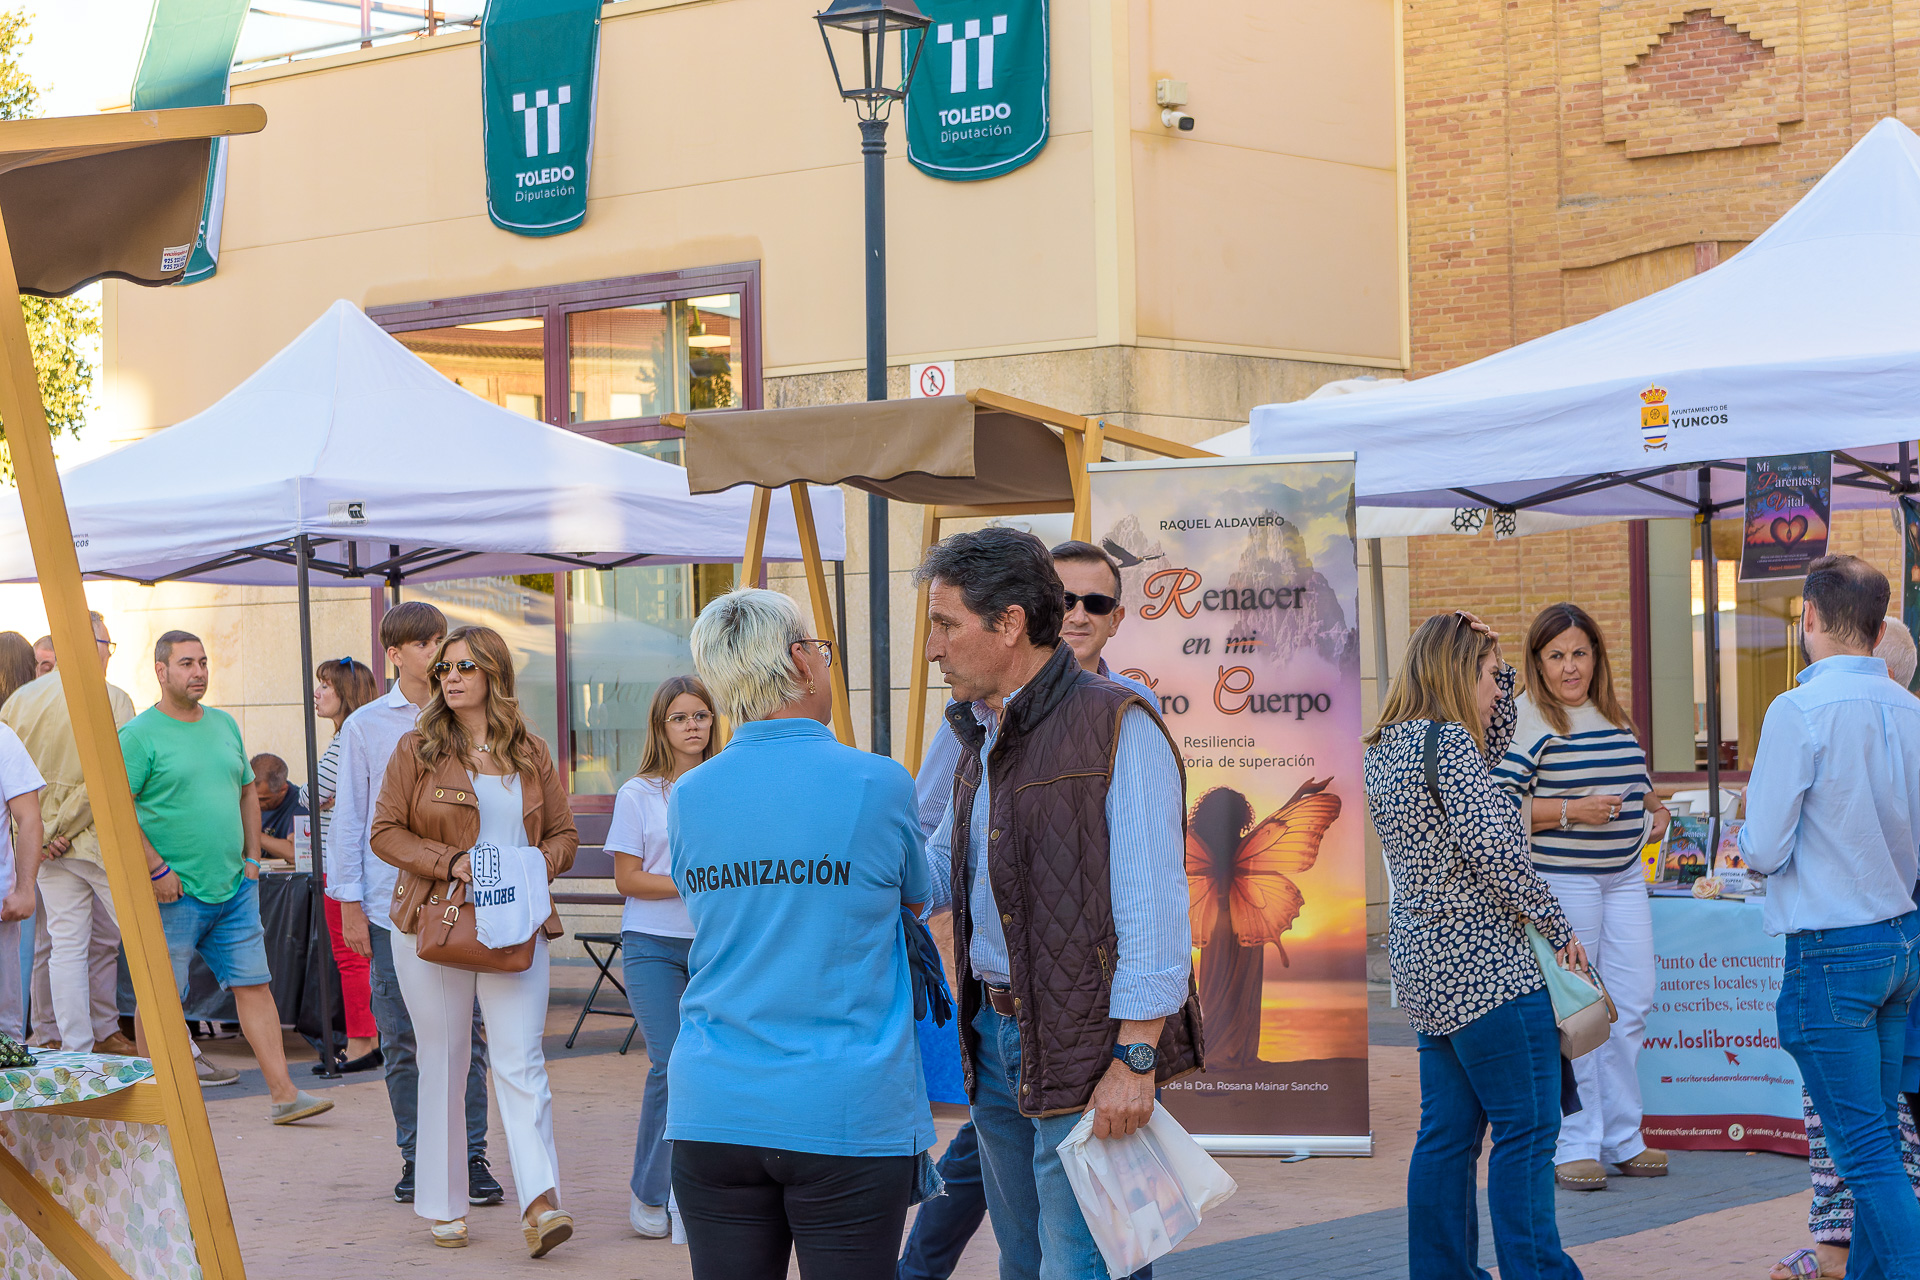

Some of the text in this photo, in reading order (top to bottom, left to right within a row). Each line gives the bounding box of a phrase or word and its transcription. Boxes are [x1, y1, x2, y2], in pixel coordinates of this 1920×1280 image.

[939, 102, 1011, 127] TOLEDO
[941, 124, 1012, 143] Diputación
[515, 165, 575, 188] TOLEDO
[515, 185, 575, 203] Diputación
[1671, 405, 1718, 416] AYUNTAMIENTO
[1671, 414, 1728, 429] YUNCOS
[1756, 461, 1770, 473] Mi
[1757, 471, 1821, 490] Paréntesis
[1766, 491, 1804, 512] Vital
[1159, 516, 1285, 532] RAQUEL ALDAVERO
[1140, 567, 1307, 620] Renacer
[1182, 630, 1257, 655] en mi
[1213, 665, 1332, 721] Cuerpo
[1183, 735, 1255, 748] Resiliencia
[1182, 754, 1315, 770] toria de superación
[686, 853, 851, 894] ORGANIZACIÓN
[474, 886, 516, 908] BROWN
[1653, 954, 1695, 970] Punto
[1698, 952, 1718, 969] de
[1660, 978, 1710, 992] autores
[1713, 975, 1758, 990] locales
[1760, 978, 1767, 993] y
[1662, 1002, 1671, 1013] o
[1673, 997, 1733, 1013] escribes,
[1168, 1080, 1182, 1090] de
[1183, 1080, 1193, 1090] la
[1194, 1081, 1215, 1091] Dra.
[1216, 1081, 1253, 1091] Rosana
[1254, 1081, 1289, 1091] Mainar
[1290, 1081, 1329, 1091] Sancho
